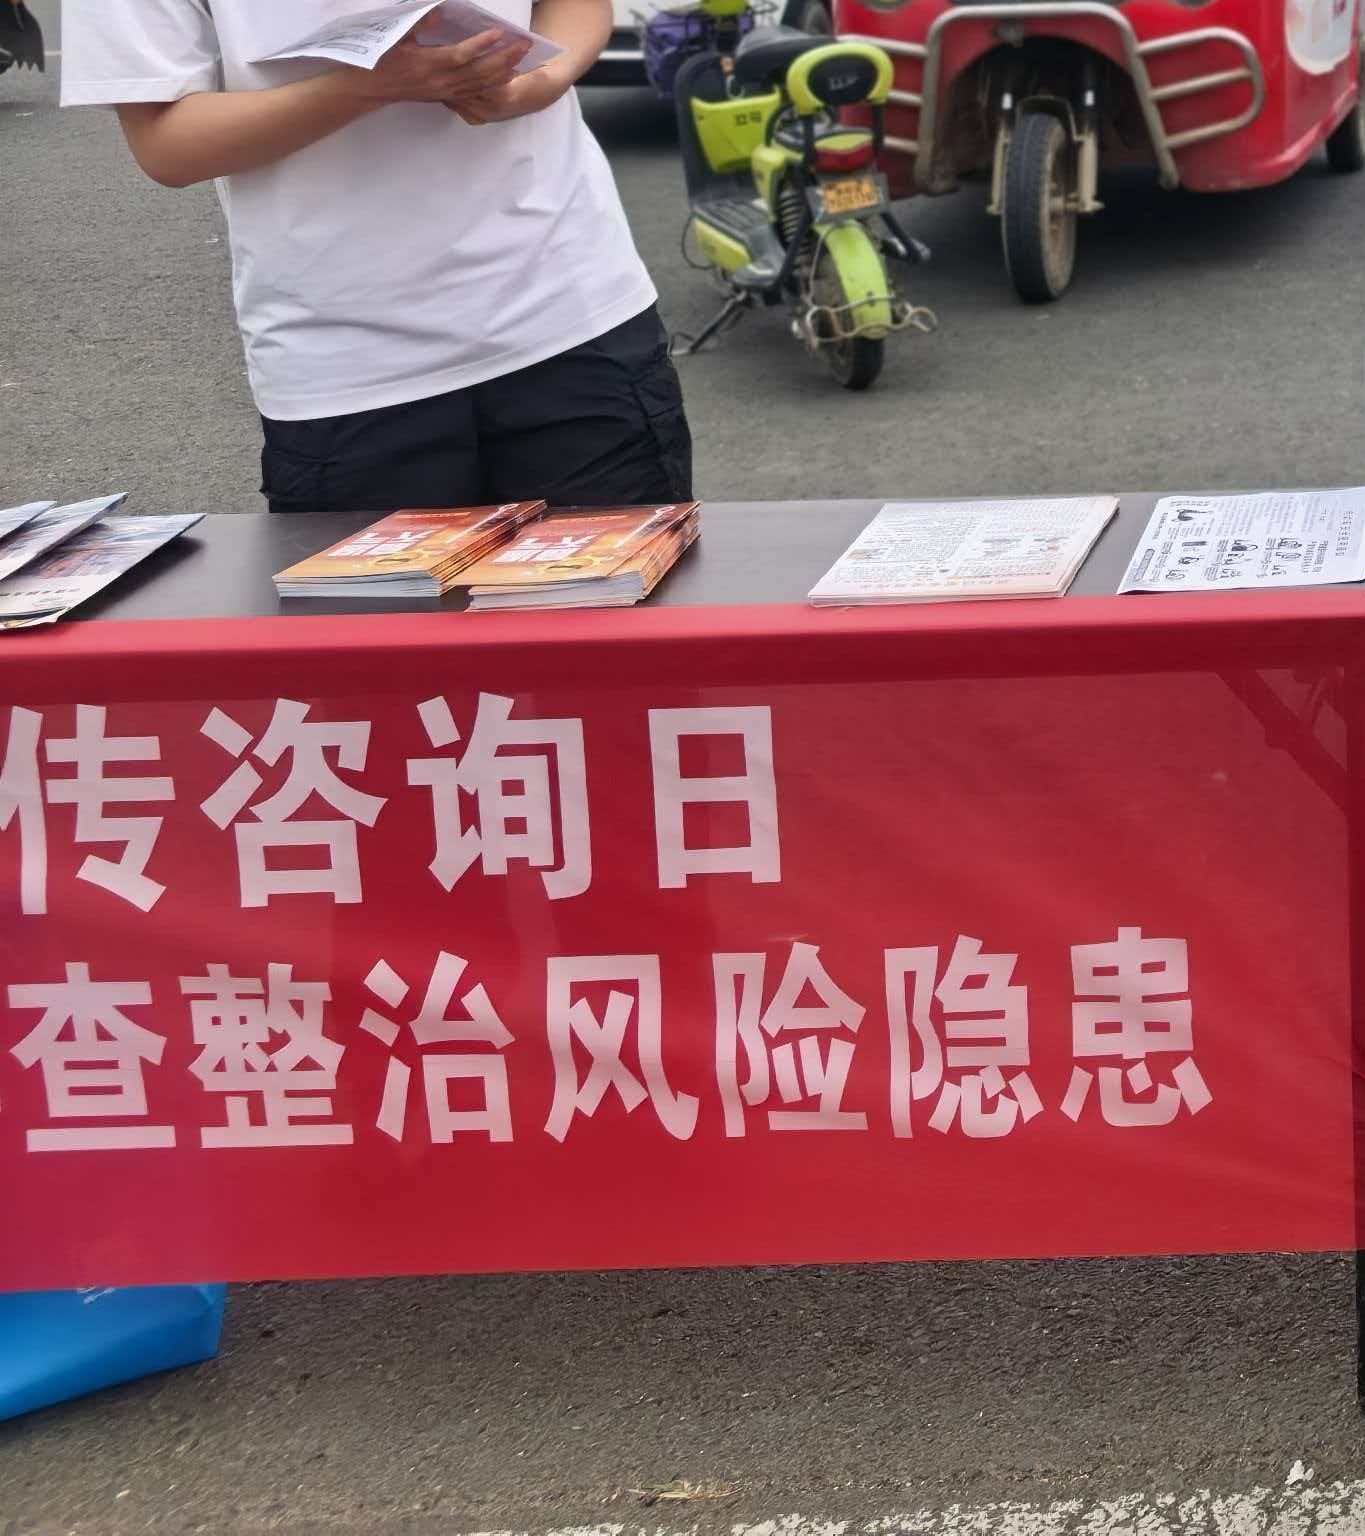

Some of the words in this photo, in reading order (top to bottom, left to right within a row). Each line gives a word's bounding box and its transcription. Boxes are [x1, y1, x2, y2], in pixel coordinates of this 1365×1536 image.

[0, 692, 782, 915] 传咨询日
[8, 925, 1213, 1153] 查整治风险隐患
